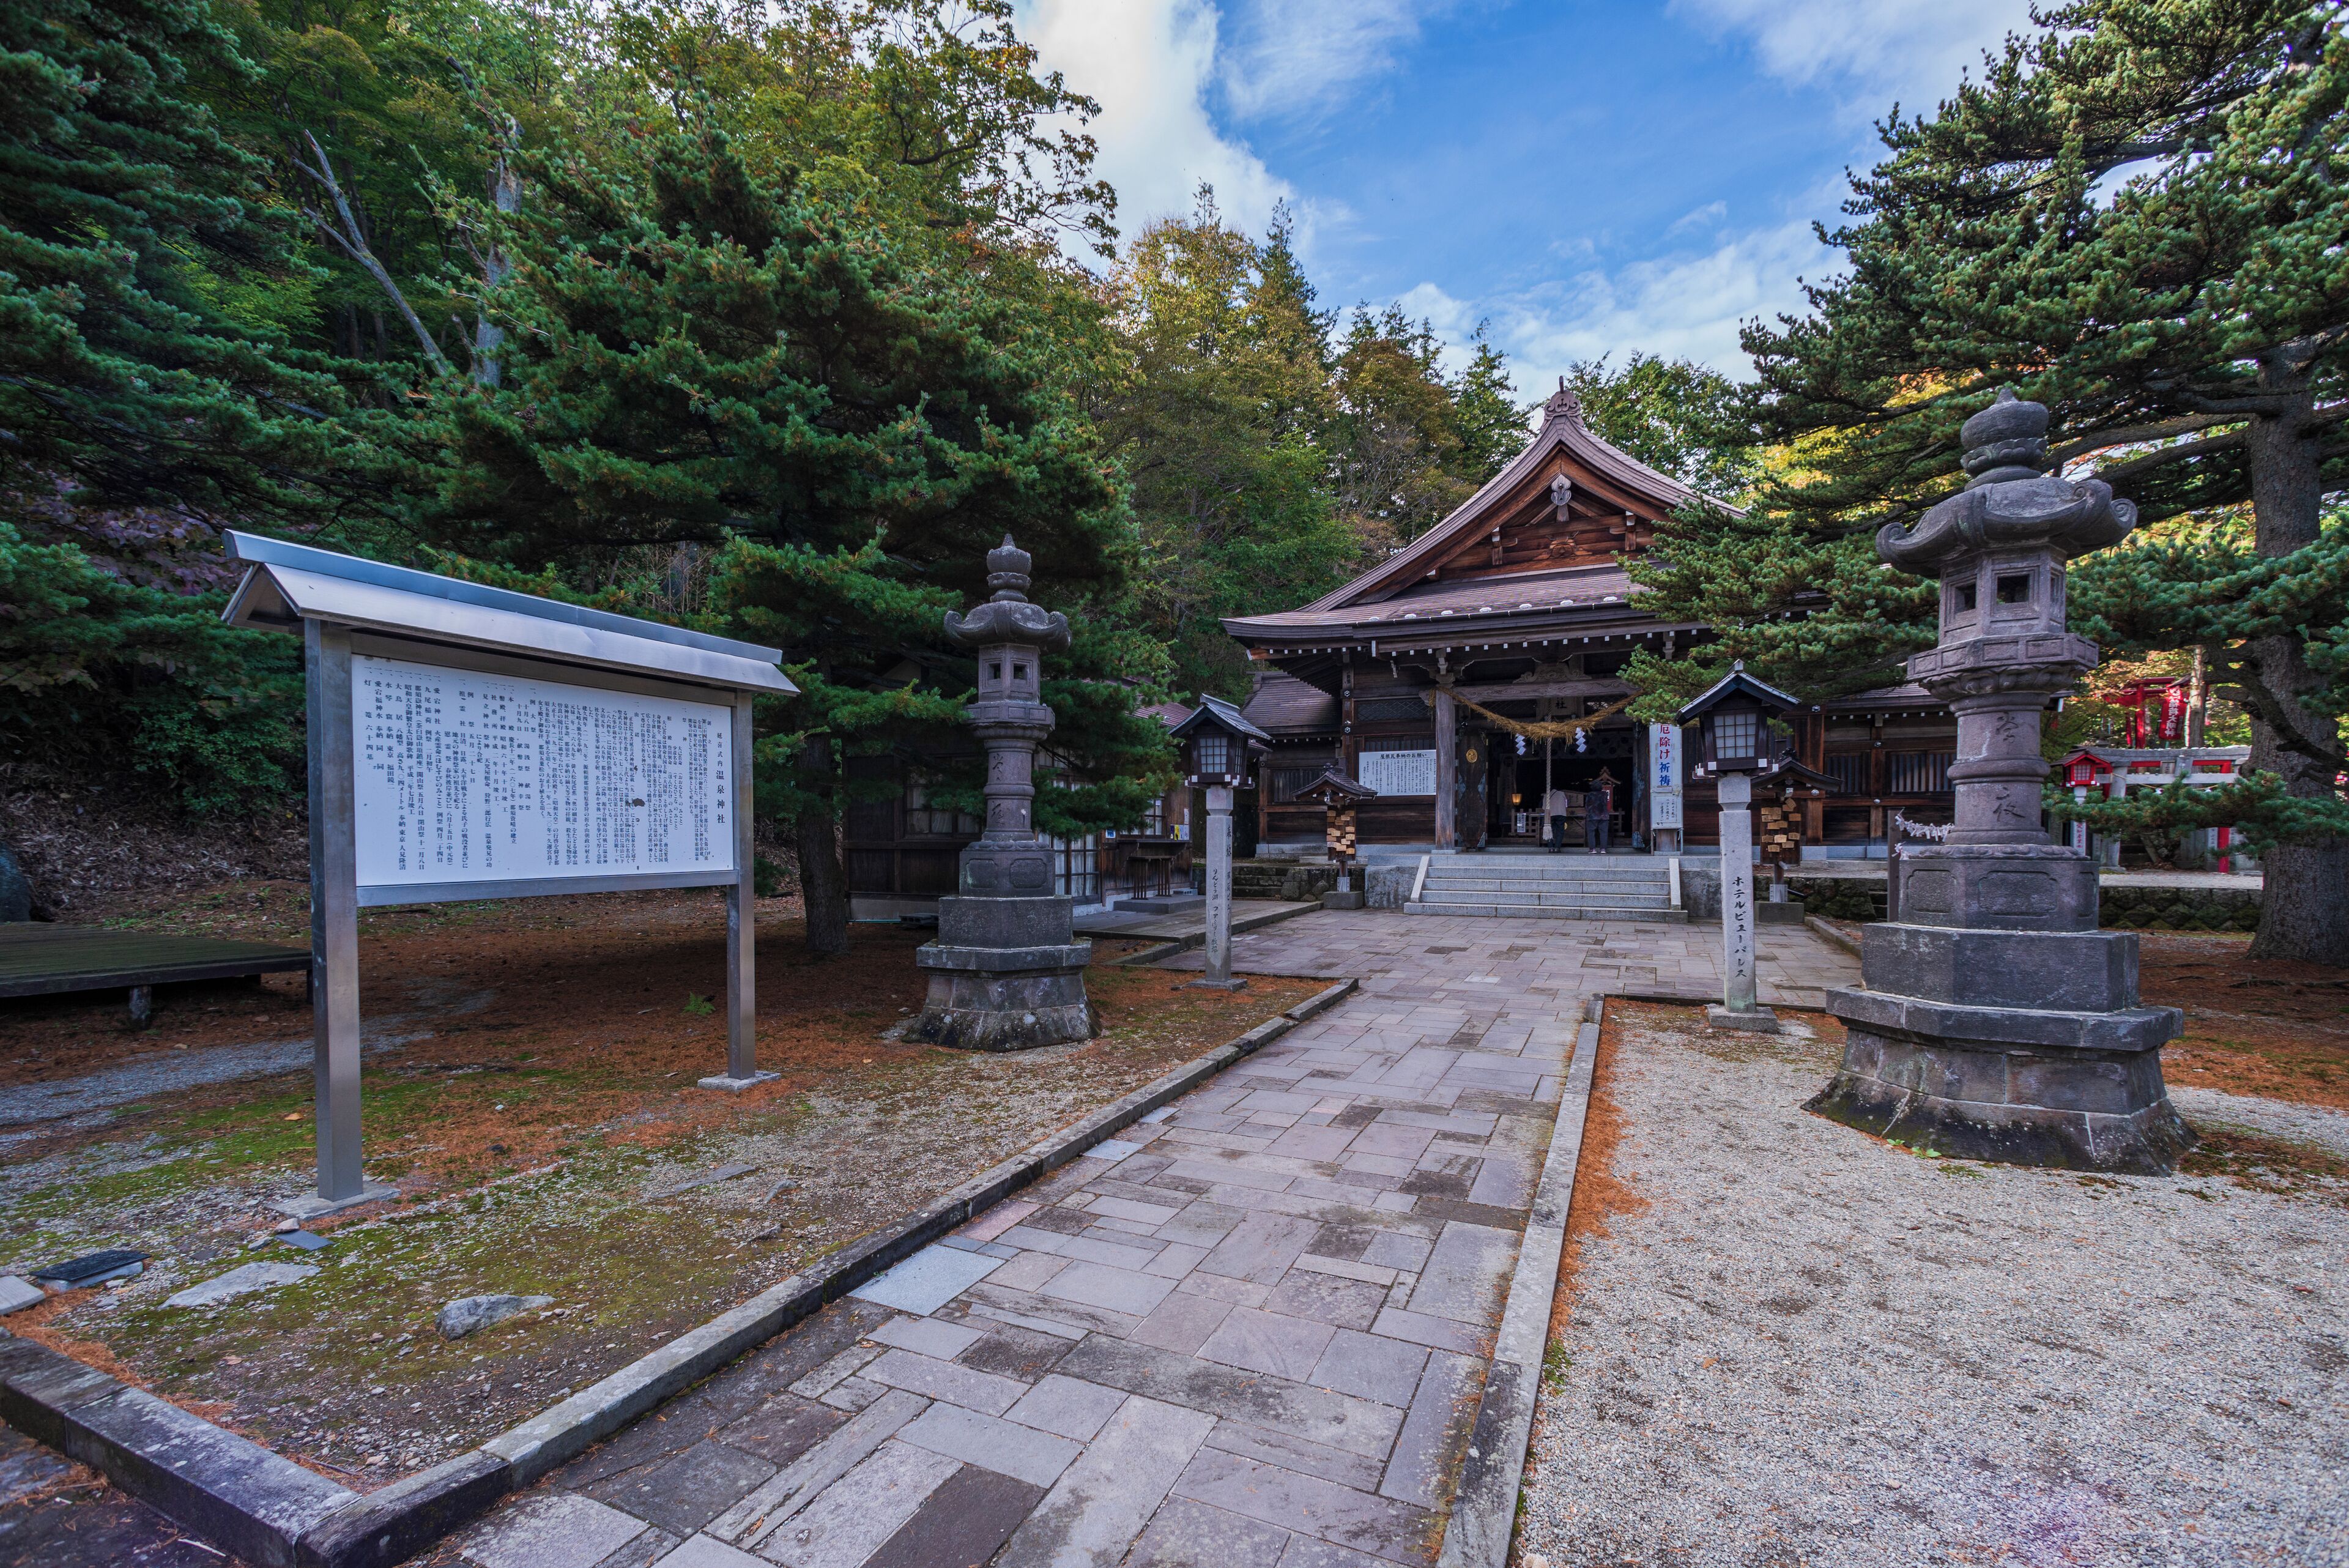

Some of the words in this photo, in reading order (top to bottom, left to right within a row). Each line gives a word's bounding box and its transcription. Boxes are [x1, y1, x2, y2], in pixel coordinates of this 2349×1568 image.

[1659, 724, 1671, 786] 厄除け祈祷
[1732, 876, 1747, 978] ホテルビューパレス
